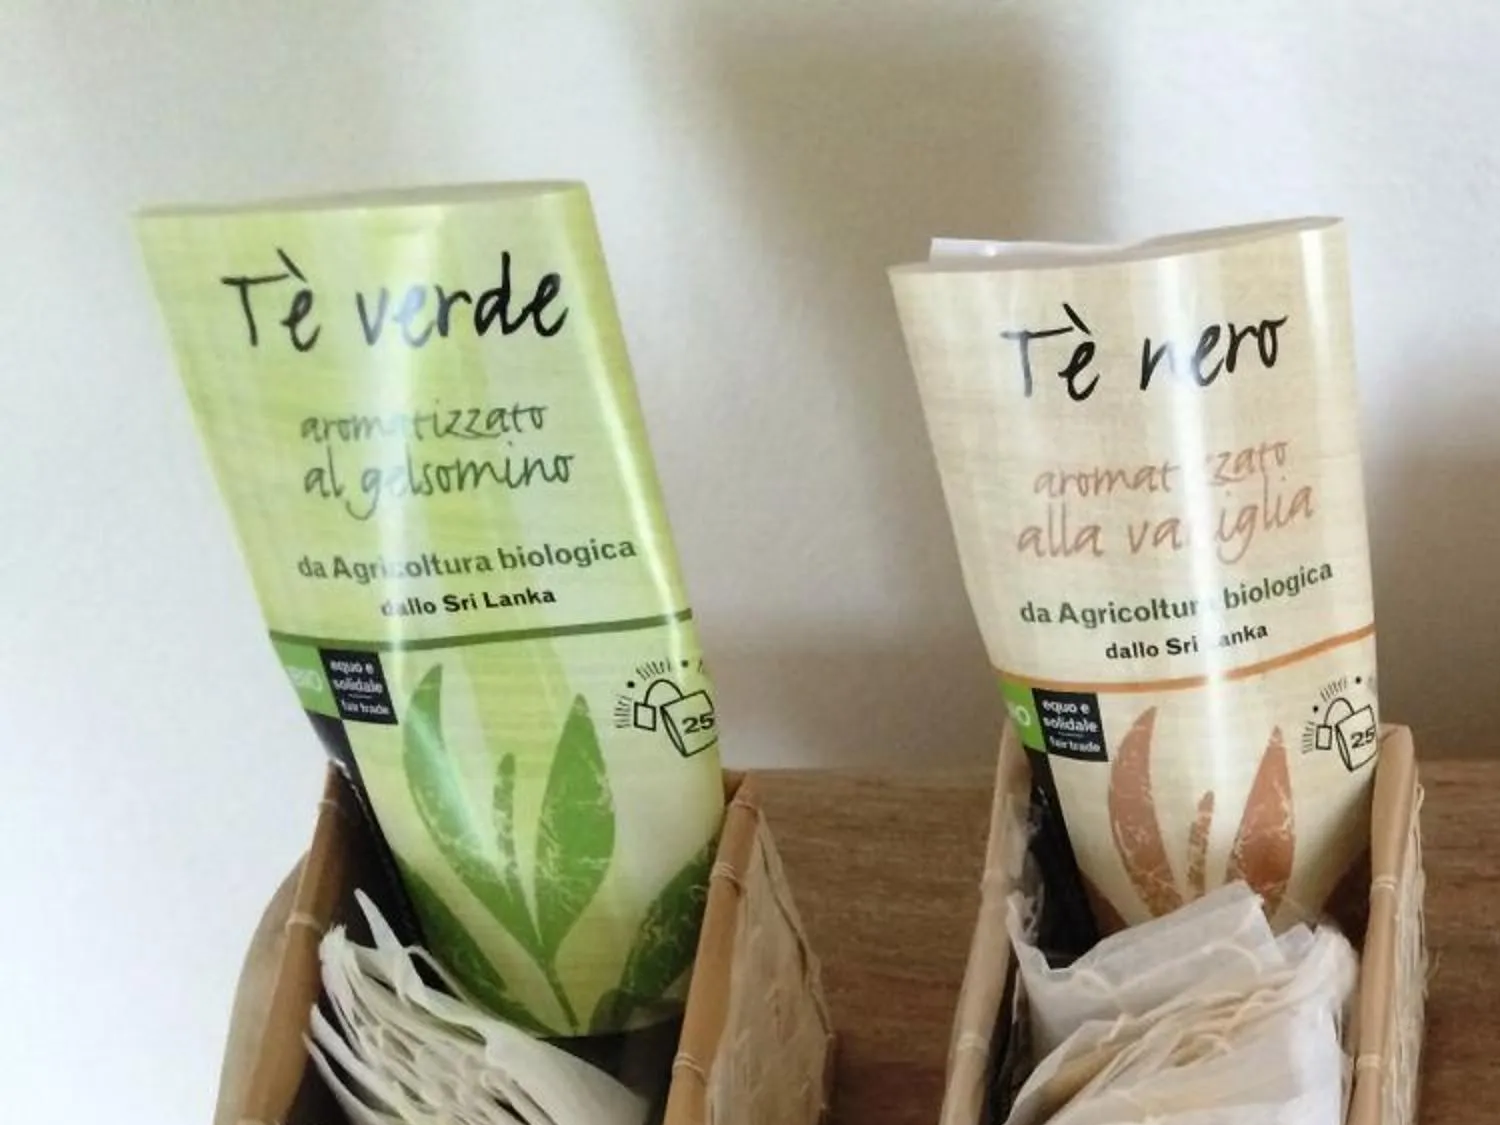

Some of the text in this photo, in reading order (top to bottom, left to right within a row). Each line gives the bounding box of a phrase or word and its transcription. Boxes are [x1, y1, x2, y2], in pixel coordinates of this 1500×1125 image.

[220, 247, 570, 352] Tè verde
[1000, 302, 1289, 402] Tè nero
[300, 398, 549, 442] aromtizzato
[303, 440, 576, 521] al gelsomino
[1033, 441, 1288, 498] aromatzato
[1016, 471, 1315, 565] alla vaiglia
[297, 555, 328, 580] da
[496, 537, 638, 571] biologica
[380, 587, 557, 618] dallo Sri Lanka
[1020, 562, 1334, 630] da Agricoltur biologica
[1104, 623, 1270, 660] dallo Sri anka
[682, 713, 716, 735] 25
[1350, 724, 1377, 749] 25
